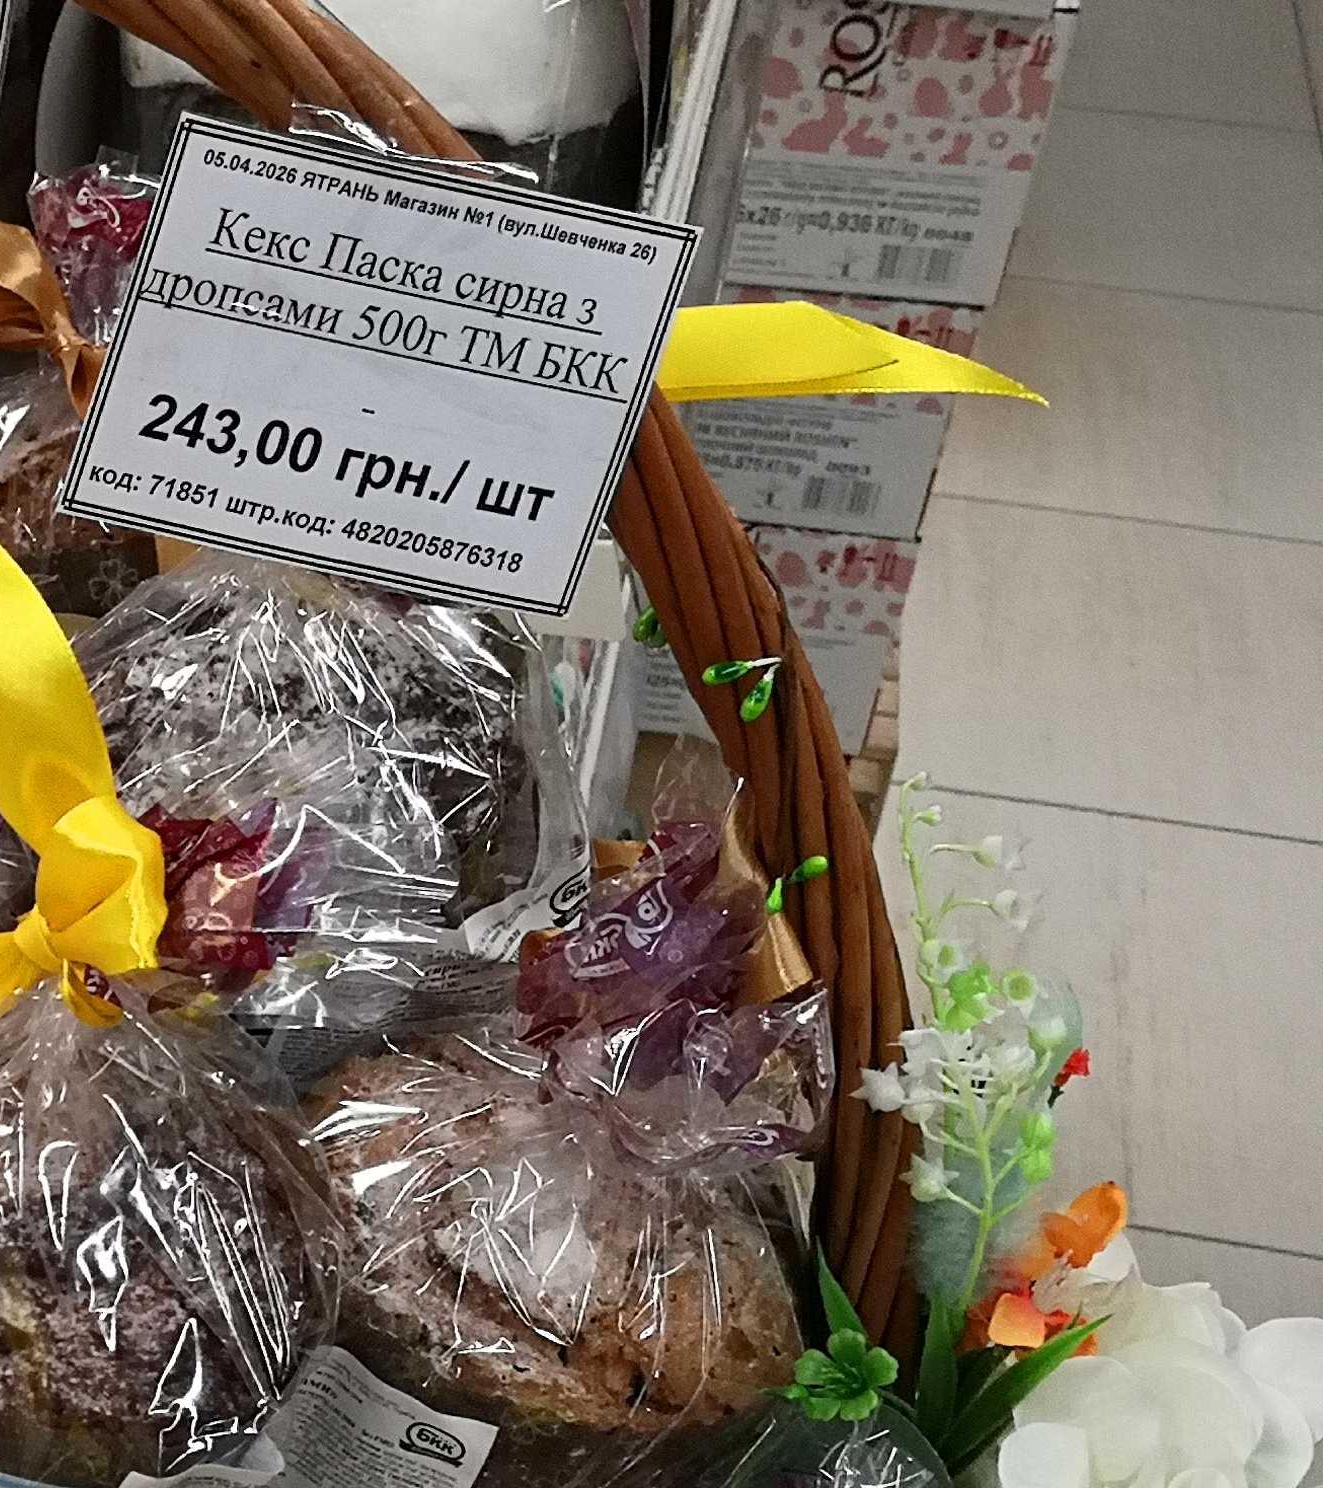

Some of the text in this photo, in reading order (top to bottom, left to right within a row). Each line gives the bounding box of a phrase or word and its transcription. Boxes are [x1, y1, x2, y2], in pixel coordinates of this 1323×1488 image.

[203, 149, 658, 266] 05.04.2026 ЯТРАНЬ Магазин №1 (вул.Шевченка 26)
[210, 207, 596, 325] Кекс Паска сирна з
[142, 268, 627, 397] дропсами 500г ТМ БКК
[138, 394, 555, 524] 243,00 грн./ шт
[88, 463, 524, 574] код: 71851 штр.код: 4820205876318
